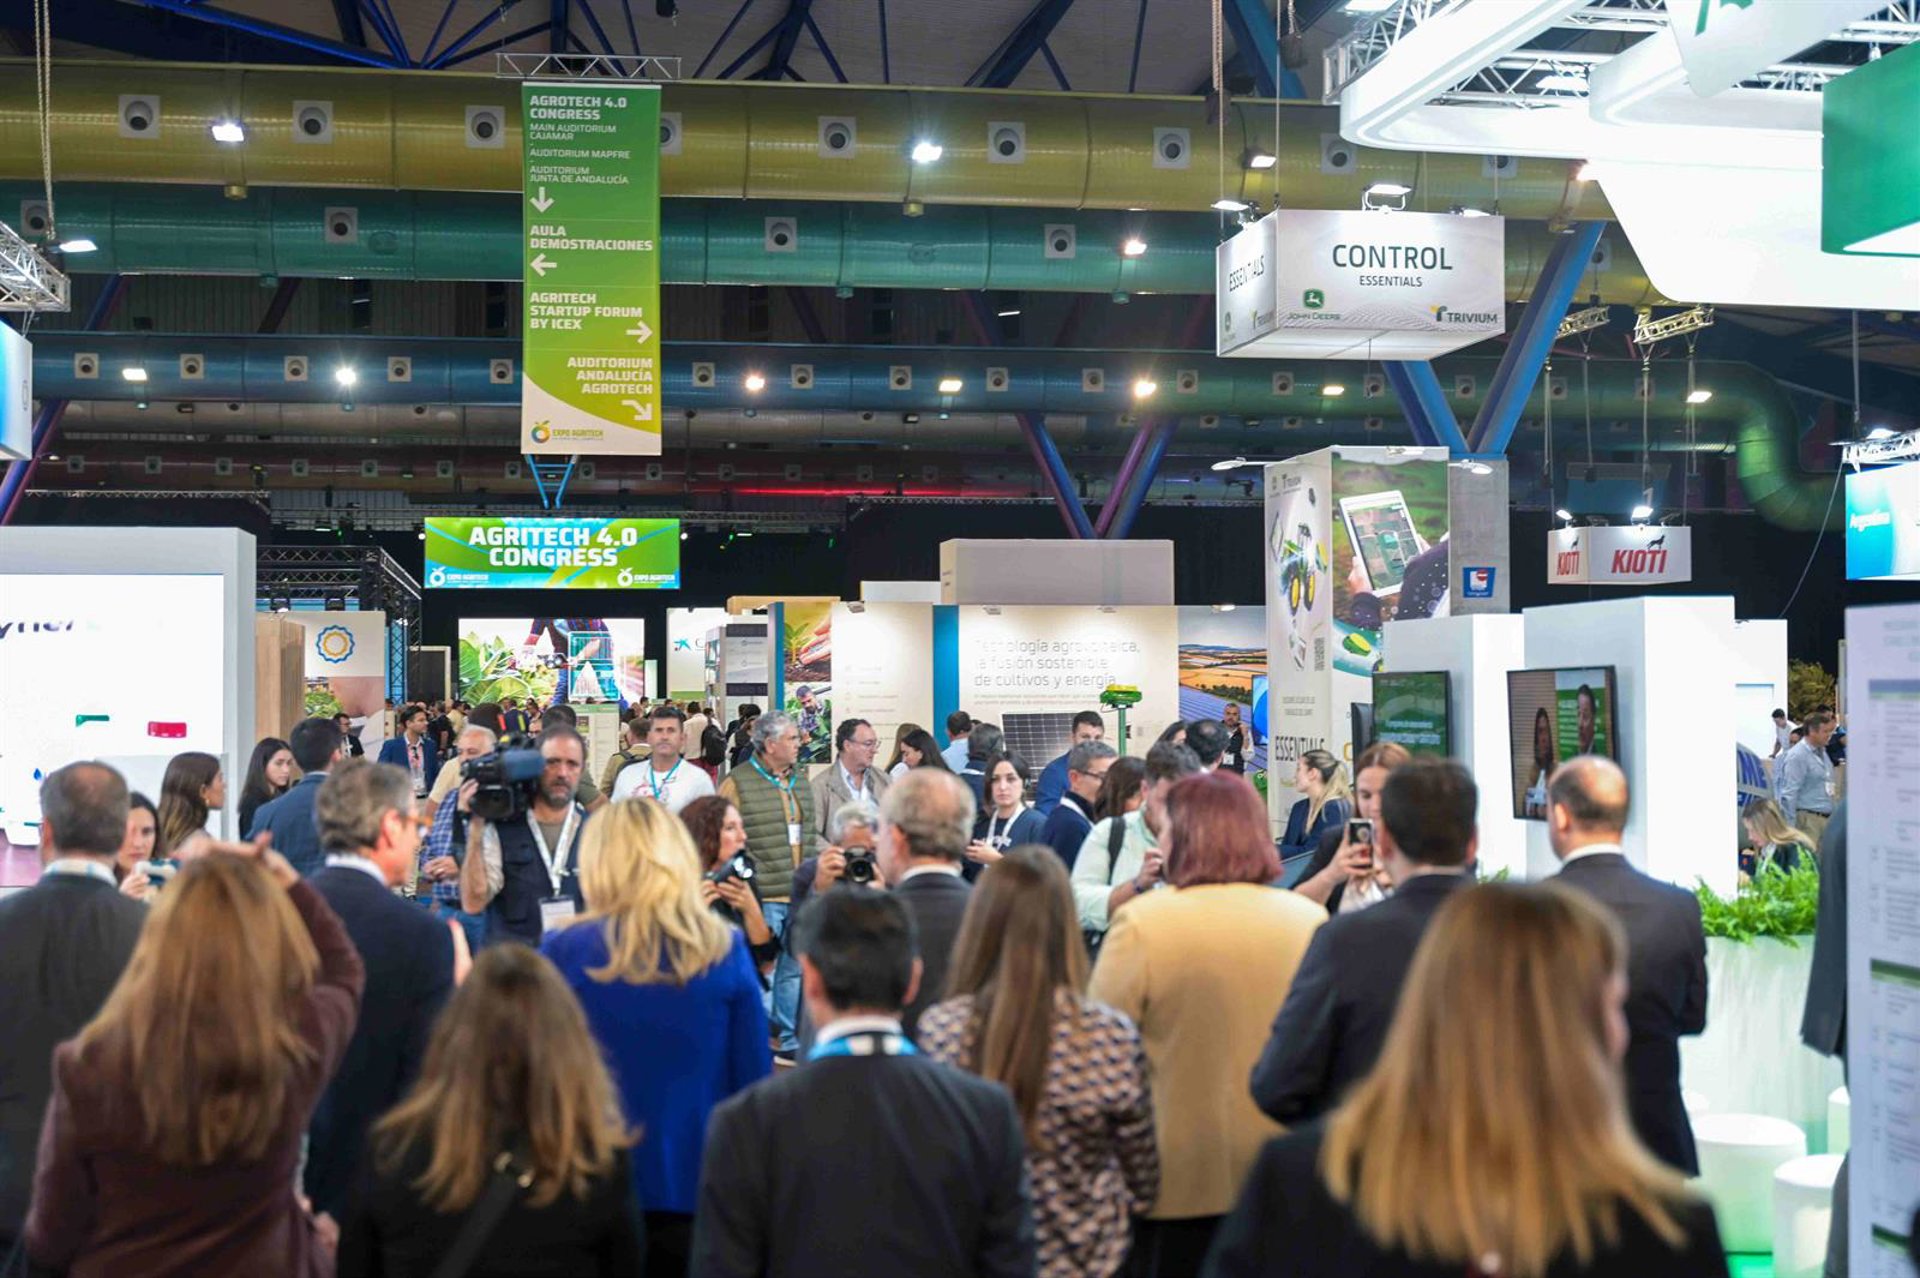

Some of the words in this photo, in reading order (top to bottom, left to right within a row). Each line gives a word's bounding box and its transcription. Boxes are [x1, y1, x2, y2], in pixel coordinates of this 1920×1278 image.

[605, 97, 627, 108] 4.0
[530, 108, 600, 120] CONGRESS
[530, 123, 555, 132] MAIN
[557, 124, 616, 133] AUDITORIUM
[530, 131, 574, 140] CAJAMAR
[530, 149, 589, 158] AUDITORIUM
[591, 150, 631, 159] MAPFRE
[530, 166, 589, 174] AUDITORIUM
[530, 174, 558, 182] JUNTA
[560, 175, 573, 183] DE
[575, 174, 629, 184] ANDALUCÍA
[530, 225, 567, 236] AULA
[530, 238, 653, 251] DEMOSTRACIONES
[1332, 244, 1453, 270] CONTROL
[1229, 255, 1264, 292] ESSENALS
[1359, 275, 1423, 288] ESSENTIALS
[530, 292, 597, 304] AGRITECH
[530, 305, 591, 317] STARTUP
[595, 307, 643, 317] FORUM
[530, 318, 548, 329] BY
[552, 318, 582, 330] ICEX
[1447, 312, 1498, 324] TRIVIUM
[567, 357, 653, 368] AUDITORIUM
[576, 370, 653, 381] ANDALUCÍA
[581, 383, 653, 394] AGROTECH
[469, 526, 590, 546] AGRITECH
[596, 527, 638, 546] 4.0
[489, 547, 618, 567] CONGRESS
[1611, 549, 1668, 574] KIOTI
[975, 639, 1048, 655] ecología
[973, 673, 993, 686] de
[996, 672, 1050, 686] cultivos
[1053, 676, 1063, 689] y
